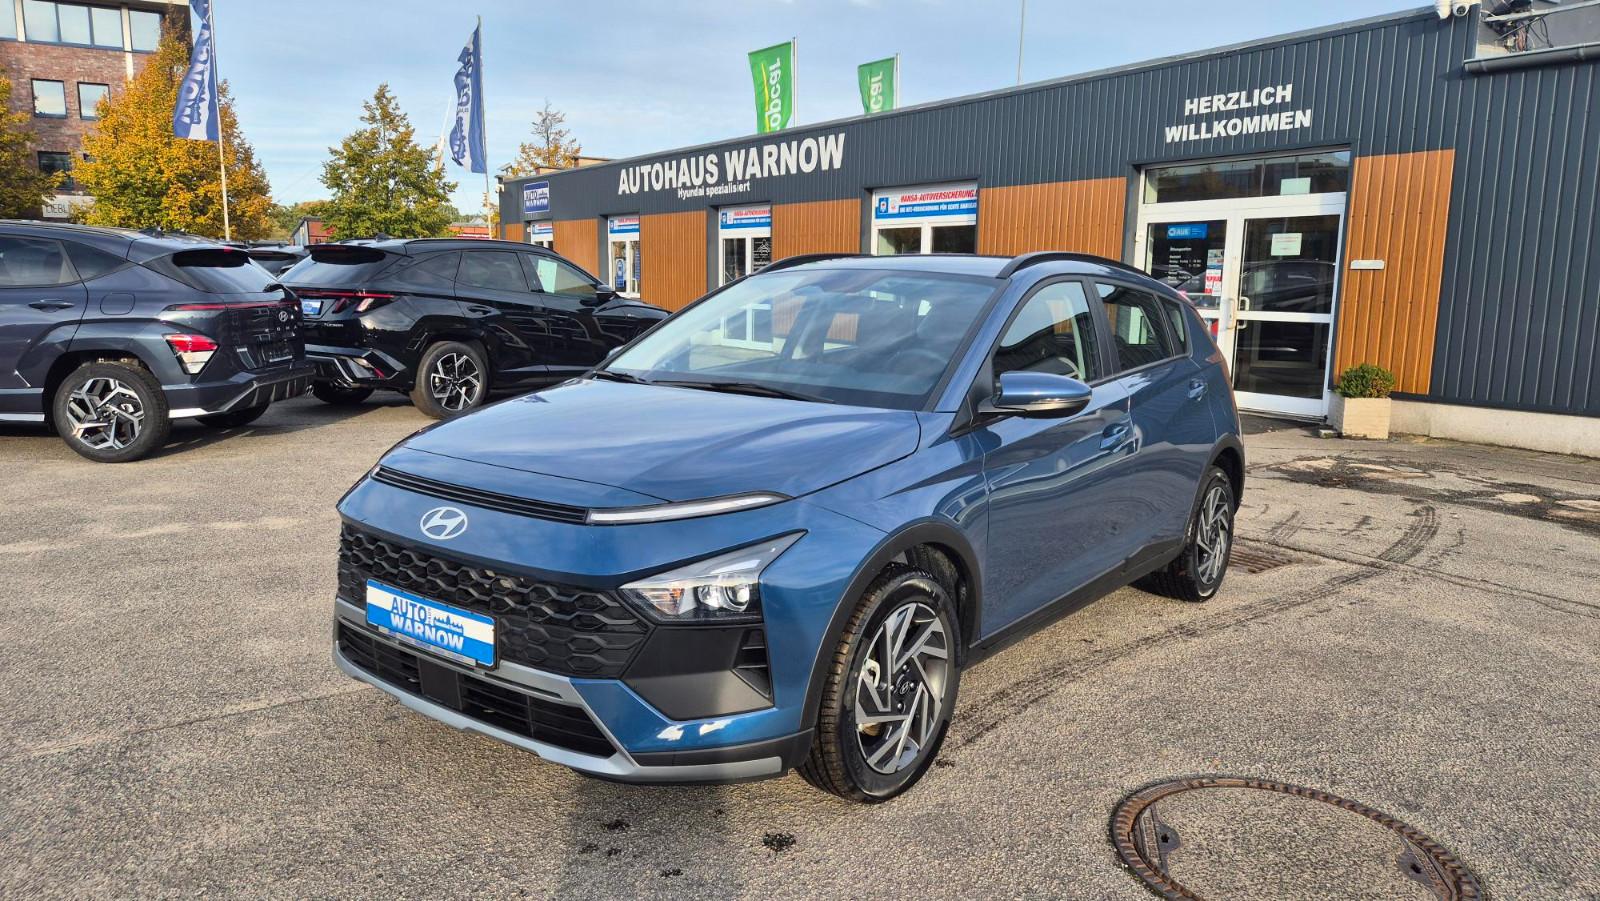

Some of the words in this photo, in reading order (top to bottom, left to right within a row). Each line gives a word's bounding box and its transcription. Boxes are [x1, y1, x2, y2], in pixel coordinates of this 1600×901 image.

[1184, 83, 1293, 116] HERZLICH
[1165, 108, 1312, 143] WILLKOMMEN
[618, 154, 719, 195] AUTOHAUS
[725, 133, 846, 182] WARNOW
[678, 186, 705, 200] Hyundai
[706, 181, 751, 198] spezialisiert
[390, 597, 428, 625] AUTO
[390, 612, 464, 652] WARNOW
